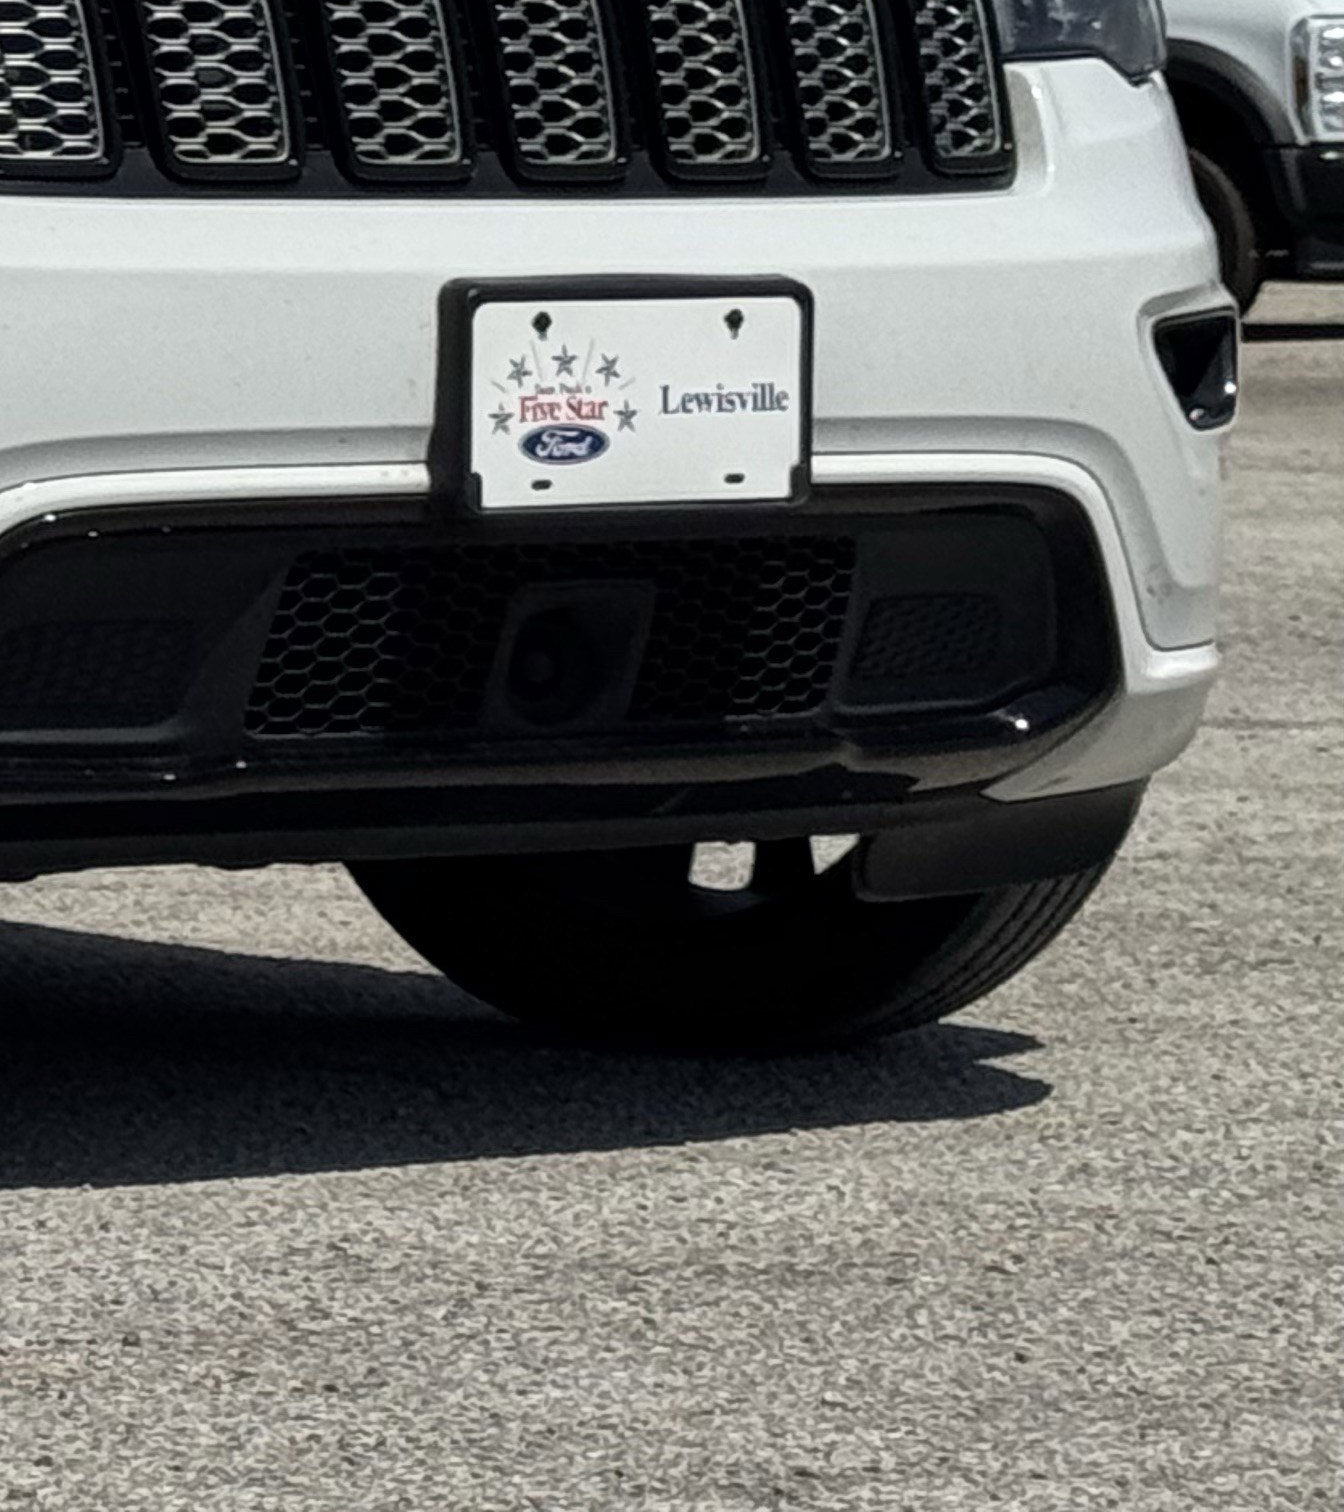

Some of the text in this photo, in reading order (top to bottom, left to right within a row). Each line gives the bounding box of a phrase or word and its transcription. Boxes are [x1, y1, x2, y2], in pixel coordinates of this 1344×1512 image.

[519, 394, 609, 423] Five Star
[658, 382, 790, 416] Lewisville
[535, 429, 593, 458] Ford
